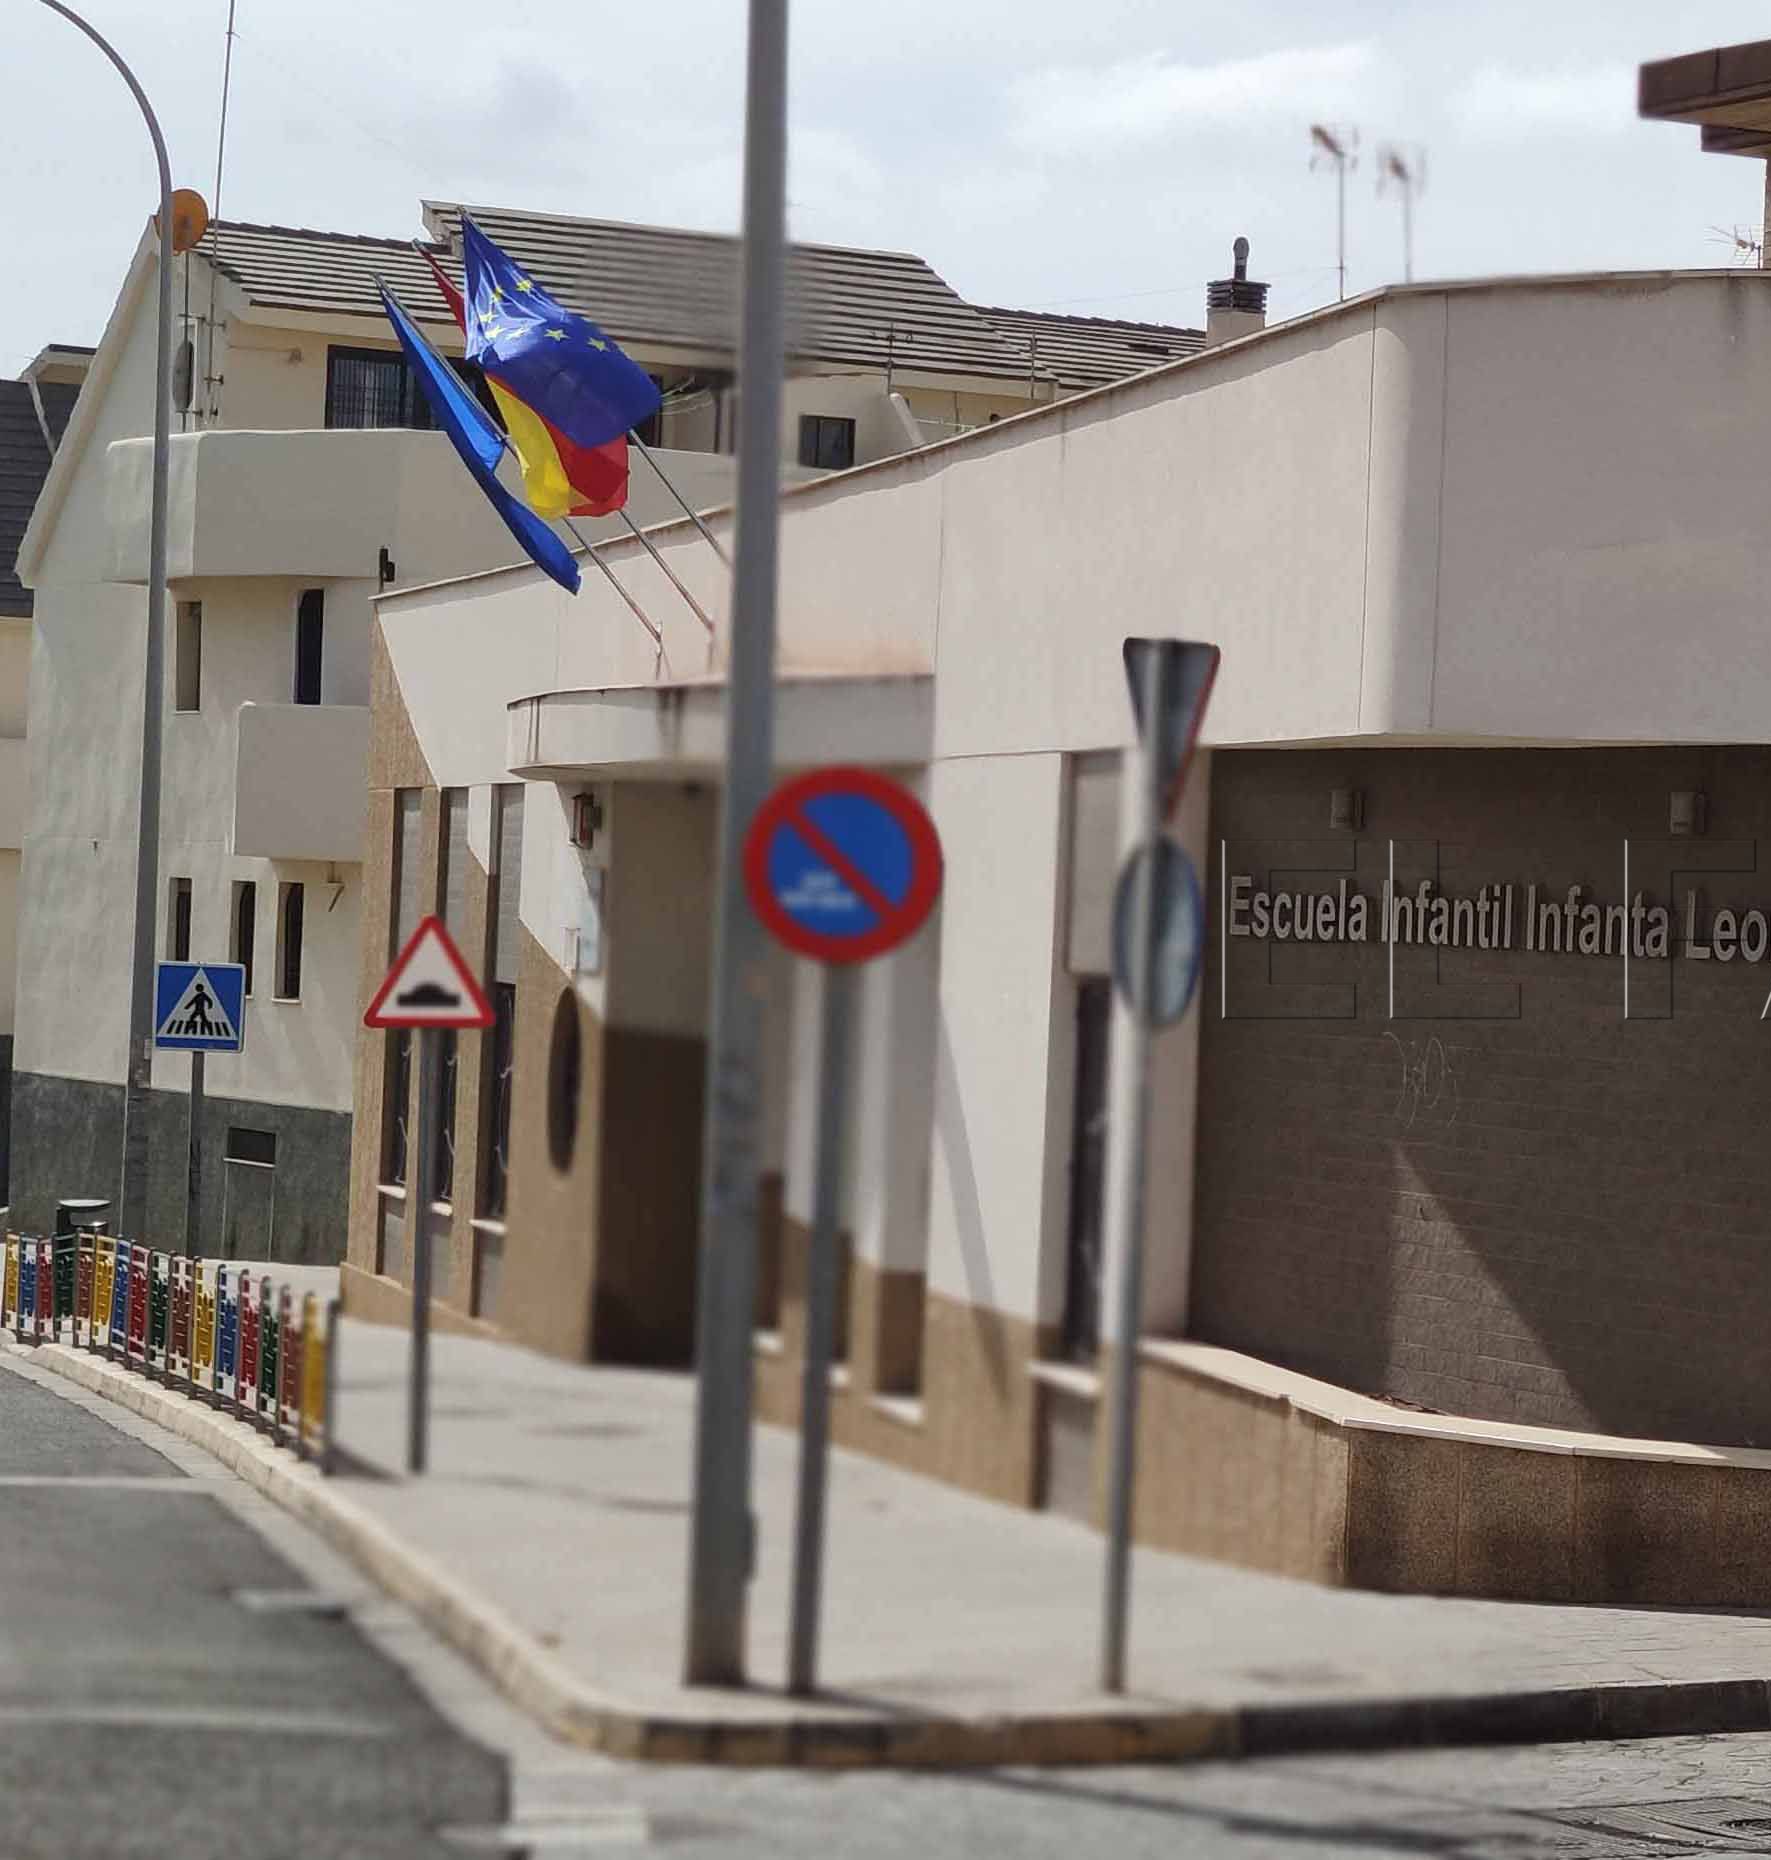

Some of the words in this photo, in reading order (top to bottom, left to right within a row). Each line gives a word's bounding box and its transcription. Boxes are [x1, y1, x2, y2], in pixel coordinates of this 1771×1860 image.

[1229, 874, 1368, 943] Escuela
[1381, 879, 1513, 949] Infantil
[1526, 883, 1669, 959] Infanta
